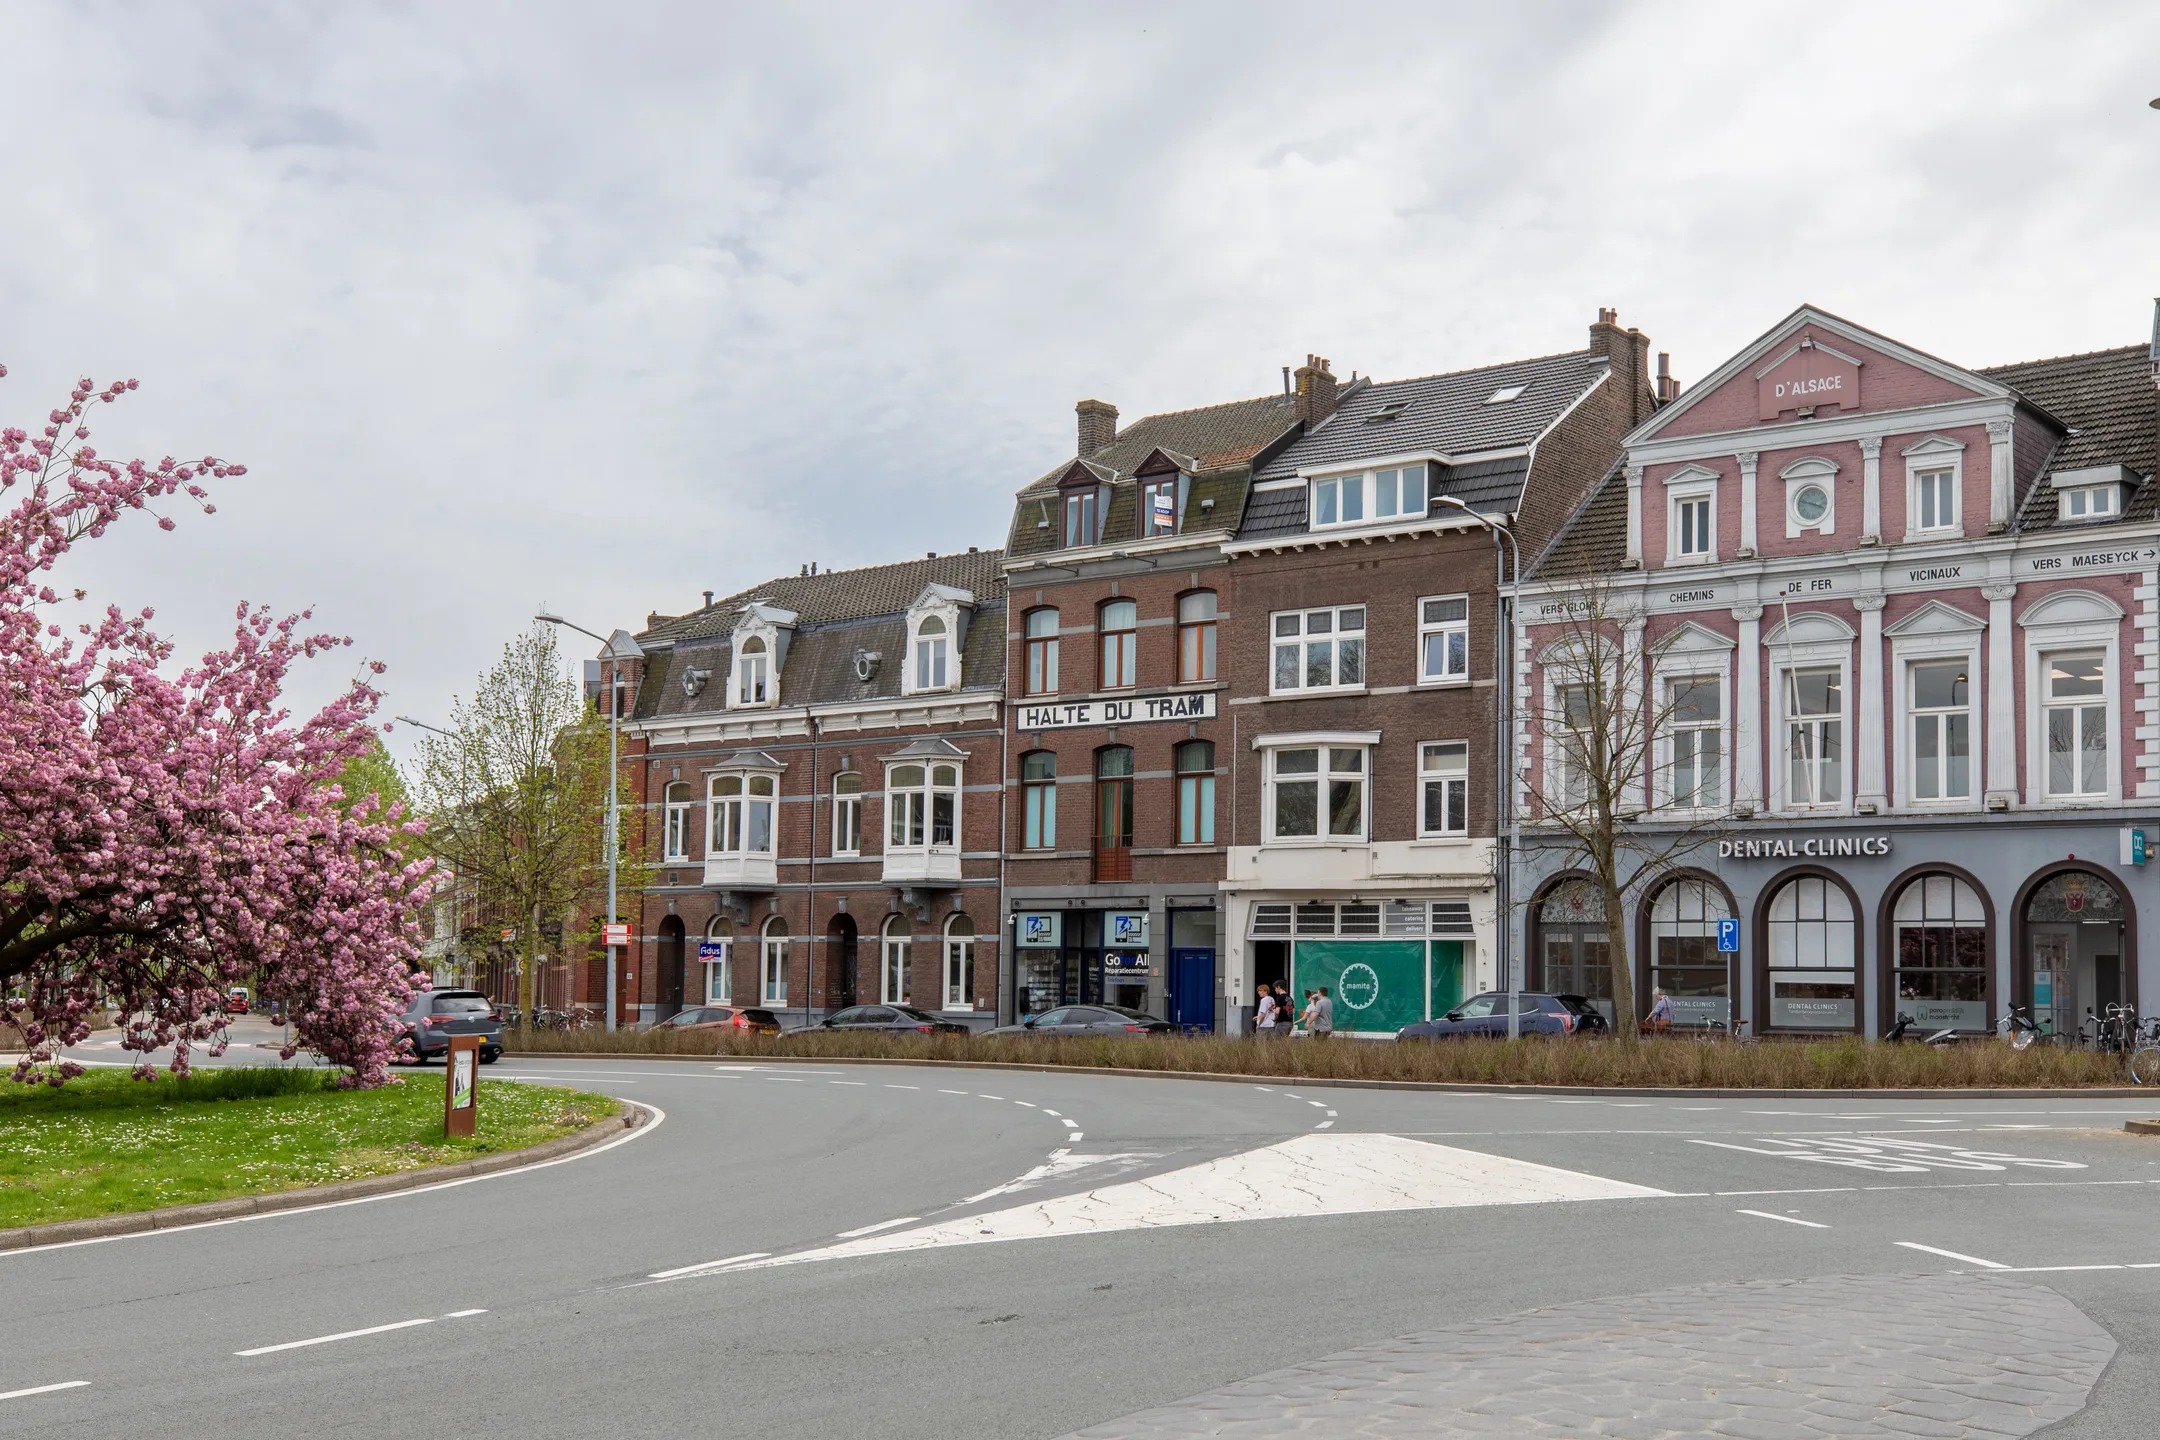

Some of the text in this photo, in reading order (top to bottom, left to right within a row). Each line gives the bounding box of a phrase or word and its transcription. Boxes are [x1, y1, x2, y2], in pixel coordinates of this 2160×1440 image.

[1775, 375, 1842, 397] D'ALSACE
[2032, 551, 2139, 570] VERS MAESEYCK
[1909, 566, 1961, 581] VICINAUX
[1788, 579, 1832, 593] DE FER
[1669, 589, 1714, 603] CHEMINS
[1540, 603, 1564, 615] VERS
[1026, 695, 1205, 726] HALTE DU TRAM
[1719, 837, 1889, 858] DENTAL CLINICS
[1722, 921, 1734, 938] P
[1346, 982, 1370, 990] mamito
[1784, 1150, 2089, 1173] BUS
